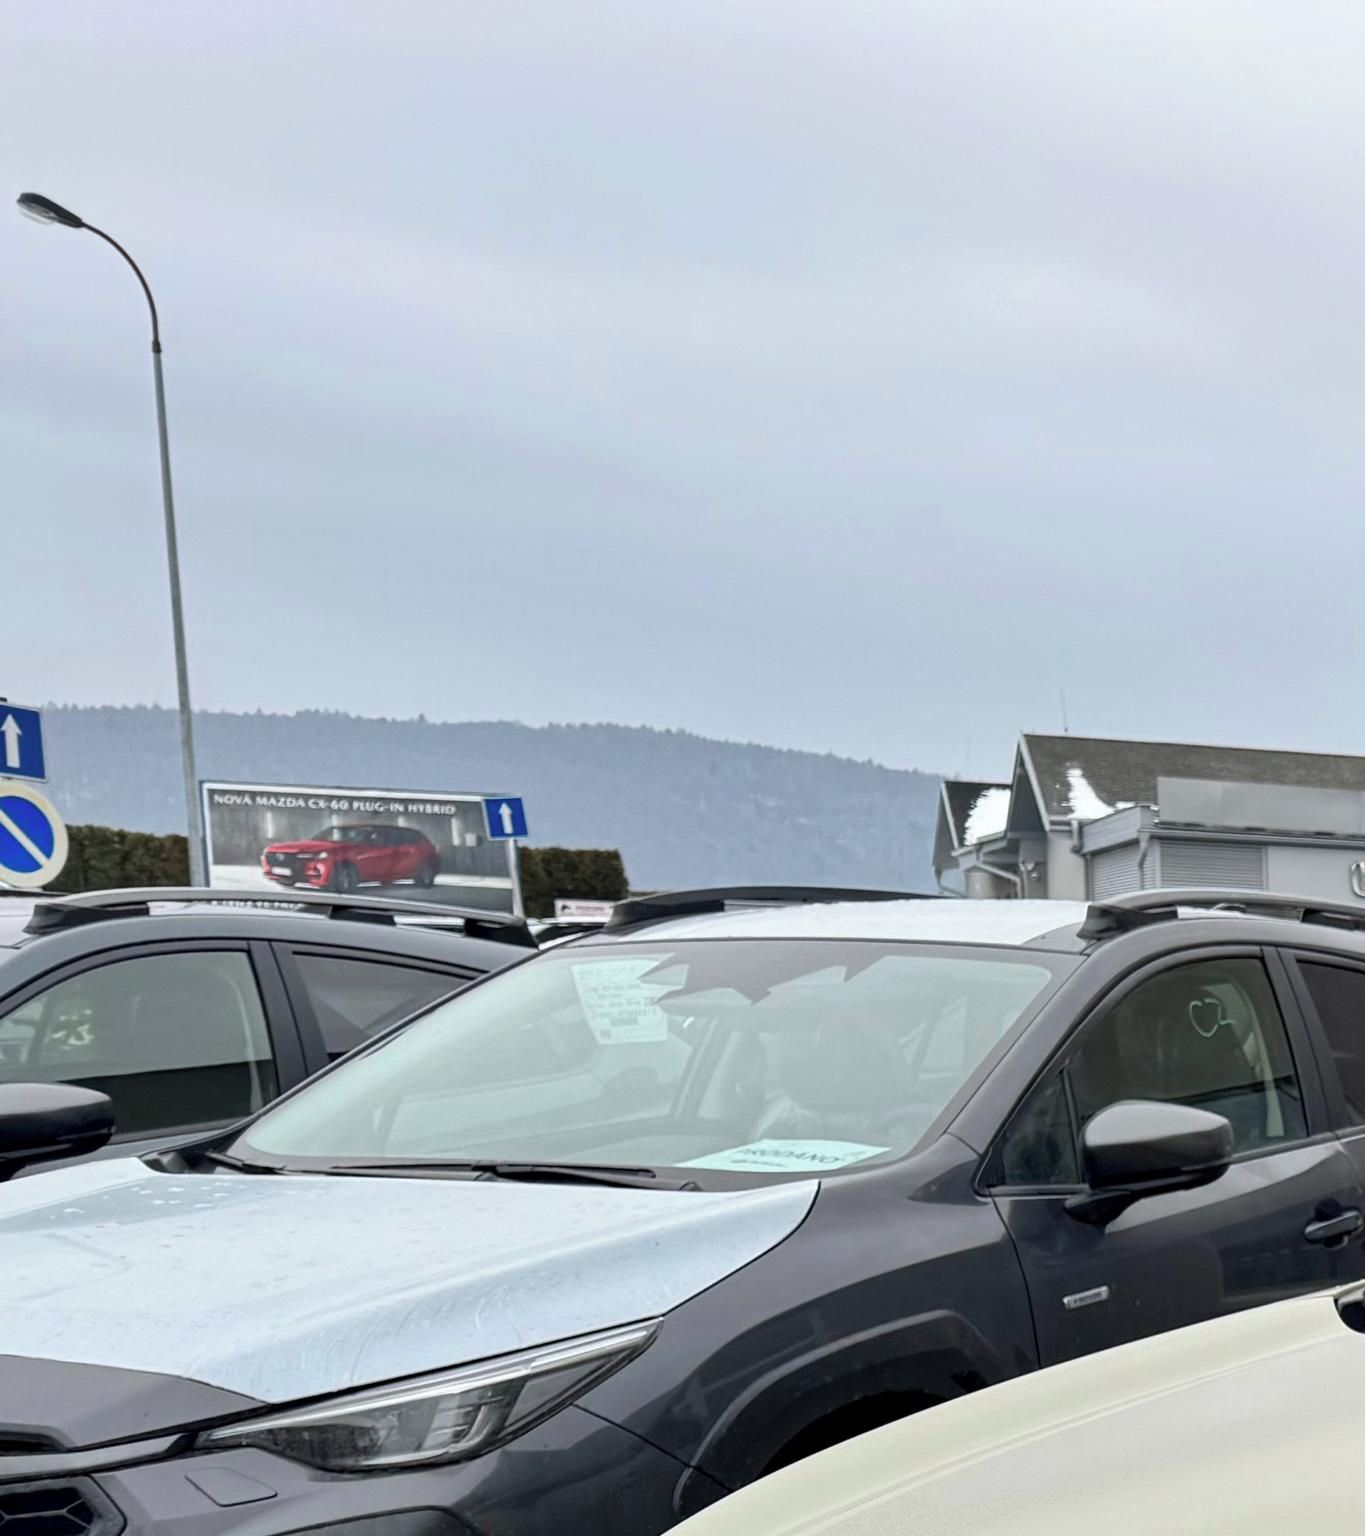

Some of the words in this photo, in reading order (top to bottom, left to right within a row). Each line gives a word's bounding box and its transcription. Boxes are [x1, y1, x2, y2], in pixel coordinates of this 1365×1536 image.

[256, 795, 306, 808] MAZDA
[352, 800, 404, 812] PLUG-IN
[408, 803, 457, 815] HYBRID
